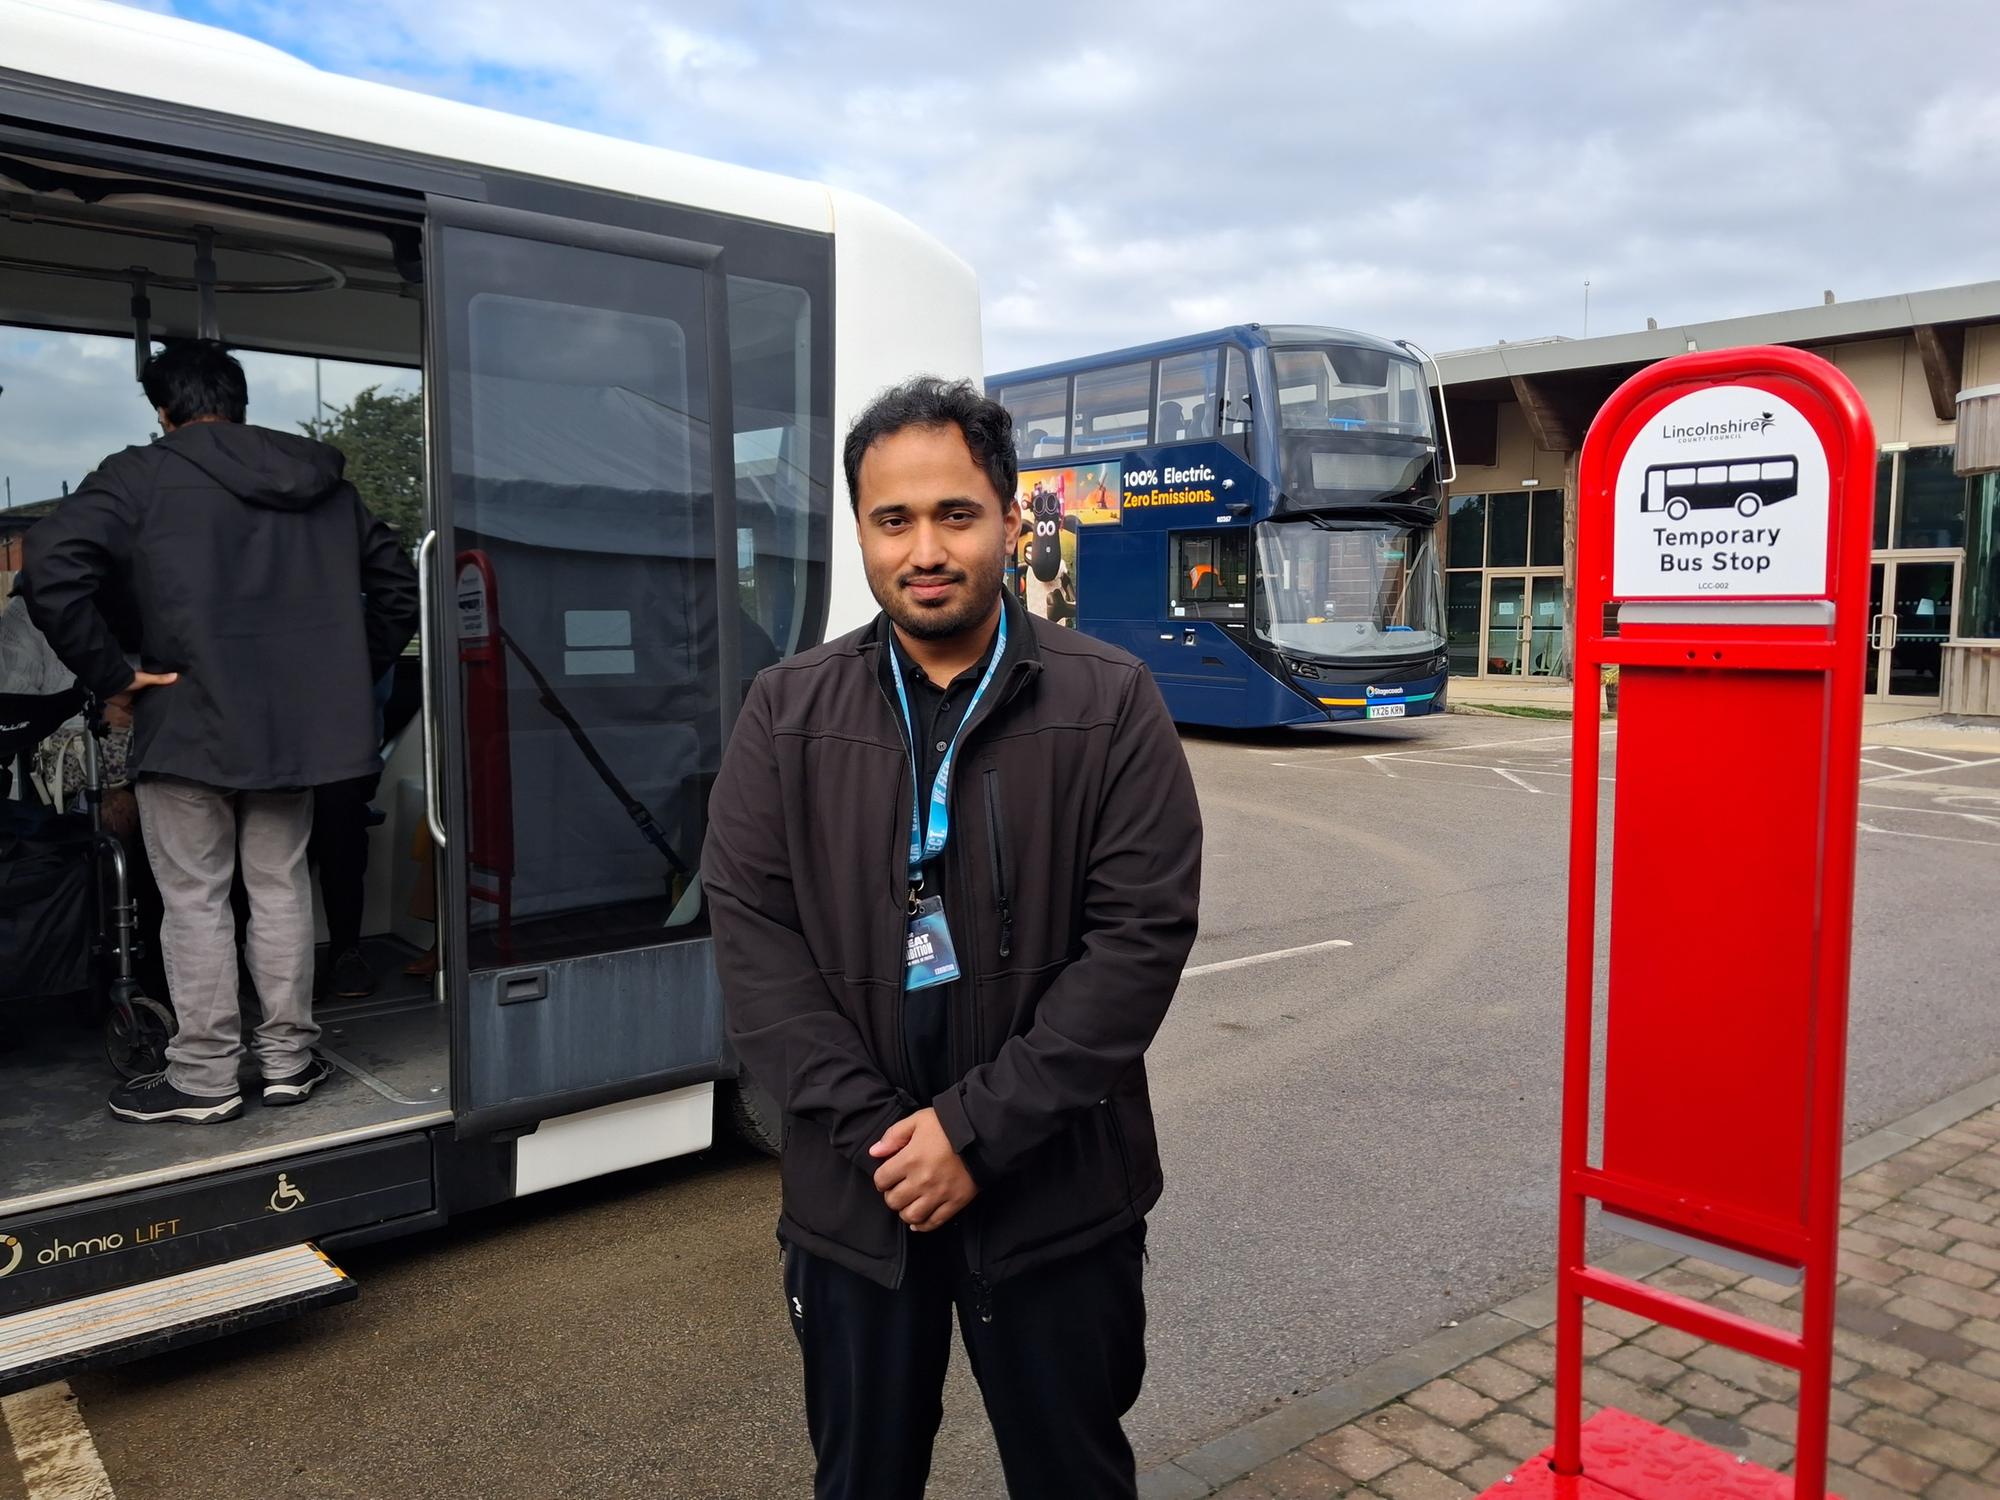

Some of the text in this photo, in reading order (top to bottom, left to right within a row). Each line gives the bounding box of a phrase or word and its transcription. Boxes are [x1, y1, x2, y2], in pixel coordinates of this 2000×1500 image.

[1663, 420, 1760, 439] Lincolnshire
[1123, 464, 1215, 487] 100% Electric.
[1123, 487, 1214, 508] Zero Emissions.
[1653, 528, 1781, 548] Temporary
[1660, 552, 1771, 573] Bus Stop
[1698, 582, 1729, 590] LCC-002
[907, 933, 929, 948] EAT
[37, 1219, 180, 1264] ohmio LIFT
